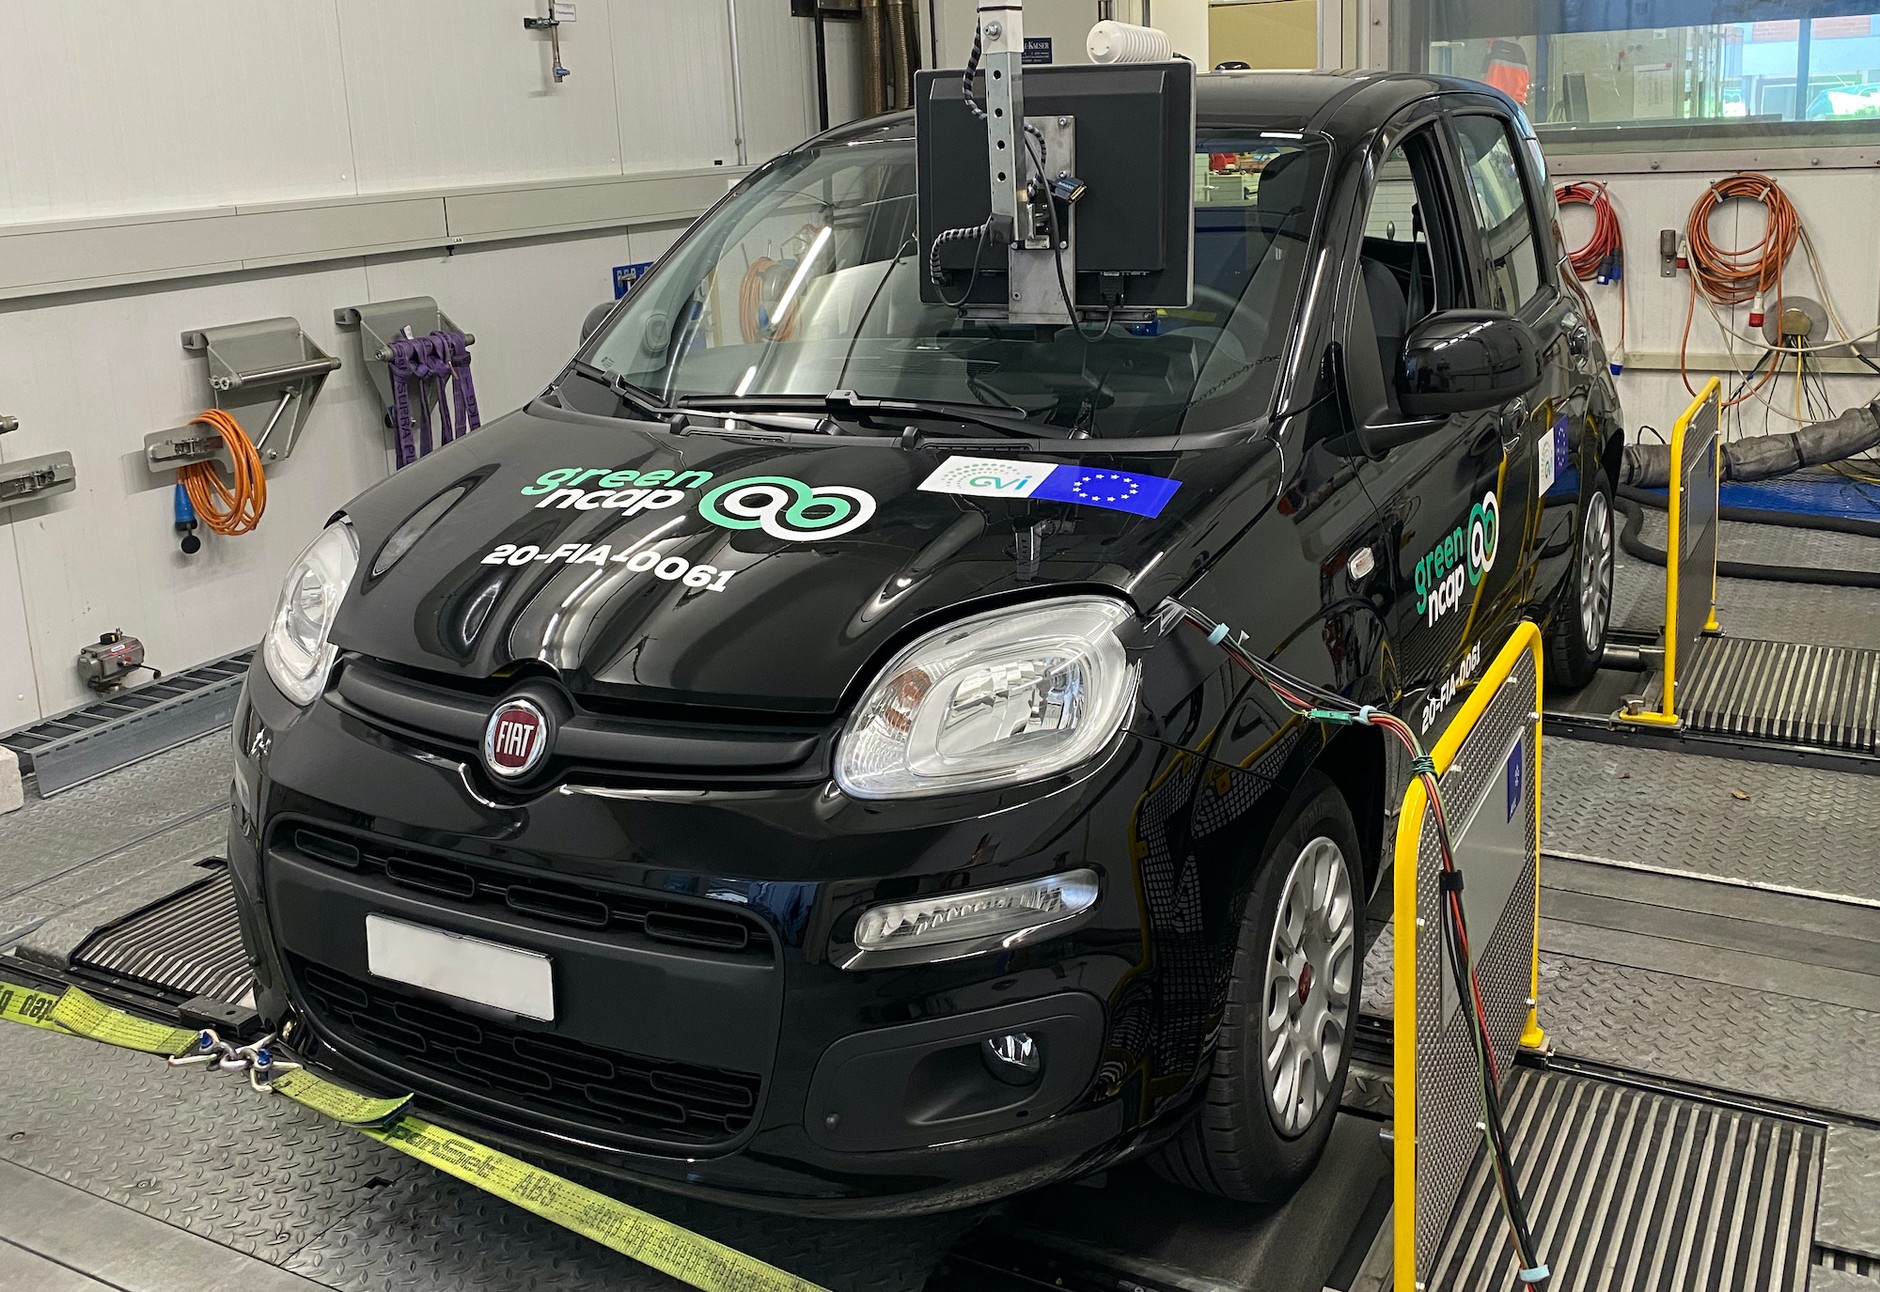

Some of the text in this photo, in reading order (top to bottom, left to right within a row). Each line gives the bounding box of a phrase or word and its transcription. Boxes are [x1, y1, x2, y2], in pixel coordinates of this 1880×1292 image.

[520, 467, 714, 496] green
[534, 486, 686, 517] ncap
[480, 543, 737, 592] 20-FIA-0061
[1414, 526, 1464, 615] green
[1428, 563, 1465, 628] ncap
[1421, 639, 1481, 736] 20-FIA-0061
[496, 721, 535, 757] FIAT
[385, 1125, 495, 1179] panSet
